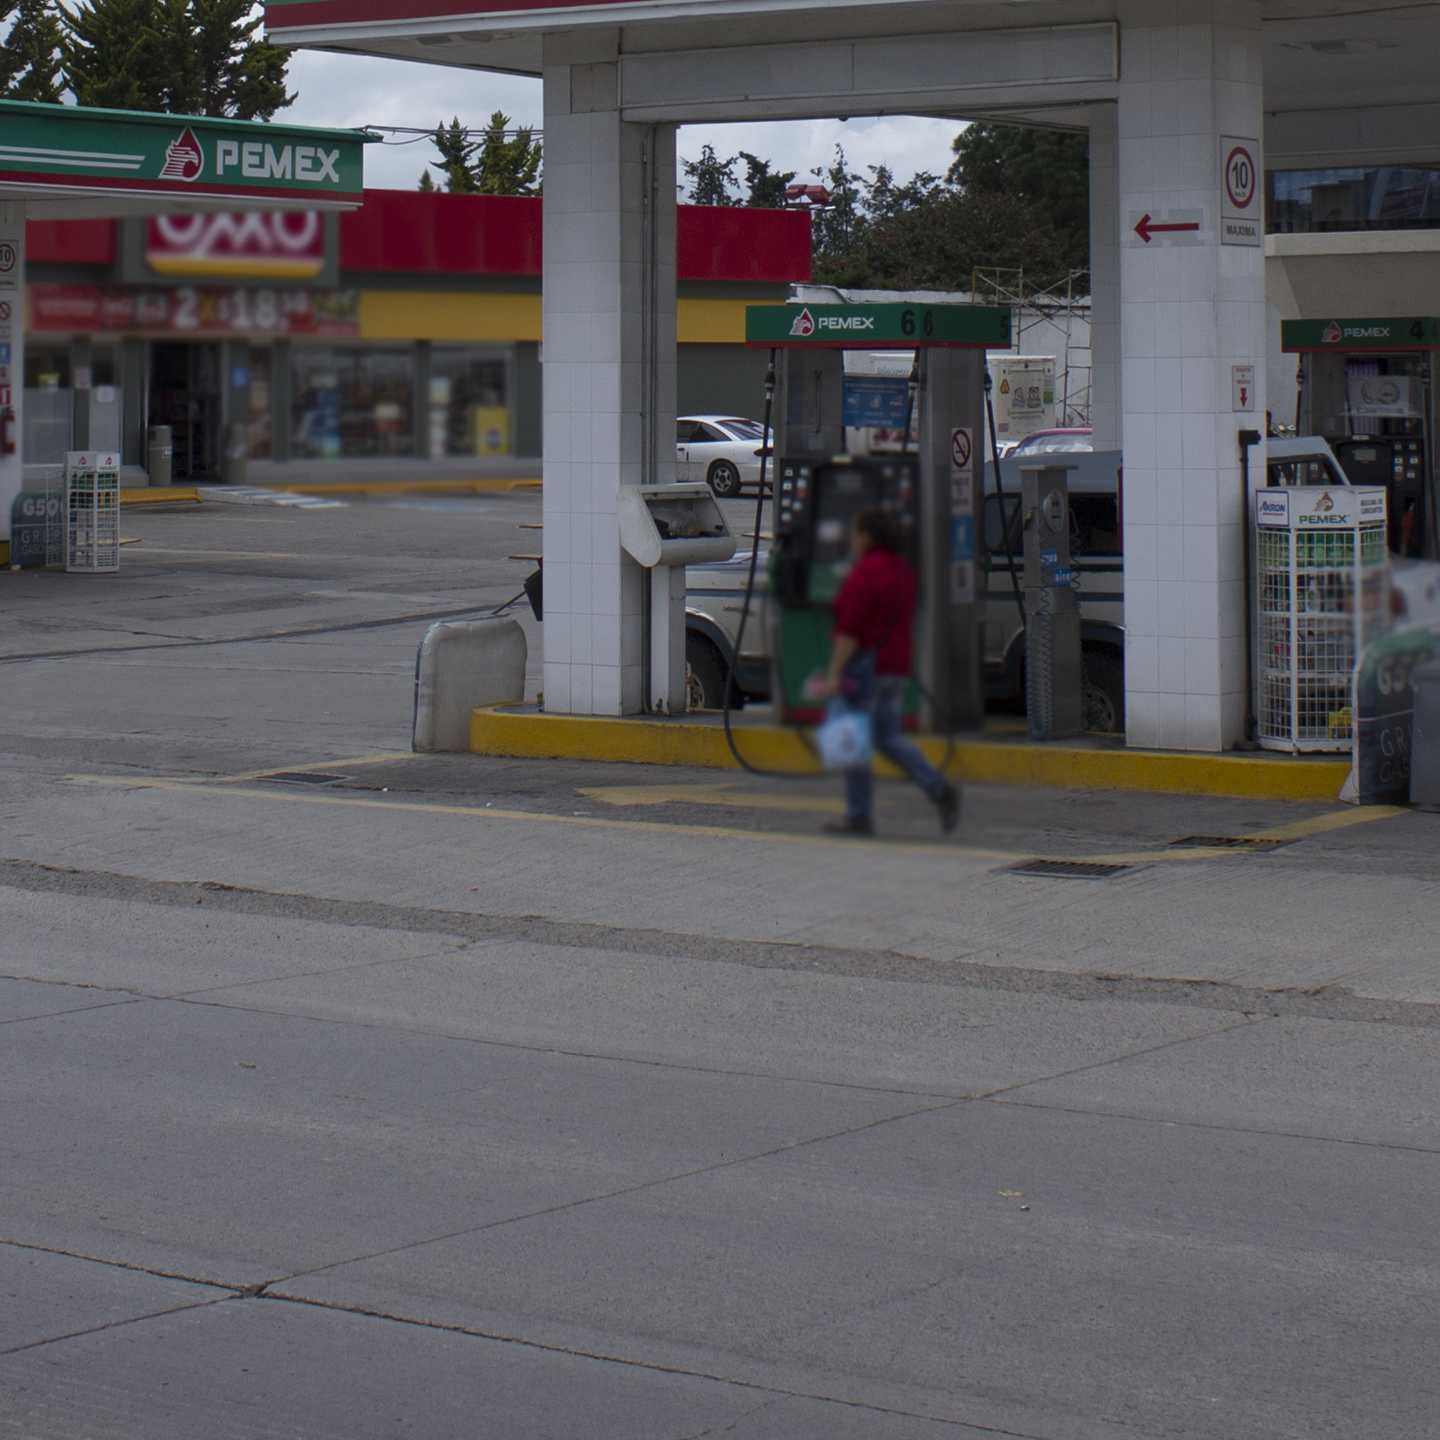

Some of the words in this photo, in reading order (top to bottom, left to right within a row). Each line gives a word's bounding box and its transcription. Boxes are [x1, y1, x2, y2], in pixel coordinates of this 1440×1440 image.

[216, 139, 340, 184] PEMEX
[1232, 161, 1248, 189] 10
[818, 316, 874, 330] PEMEX
[900, 310, 916, 336] 6
[1343, 327, 1390, 337] PEMEX
[1410, 320, 1425, 340] 4
[1298, 514, 1347, 525] PEMEX
